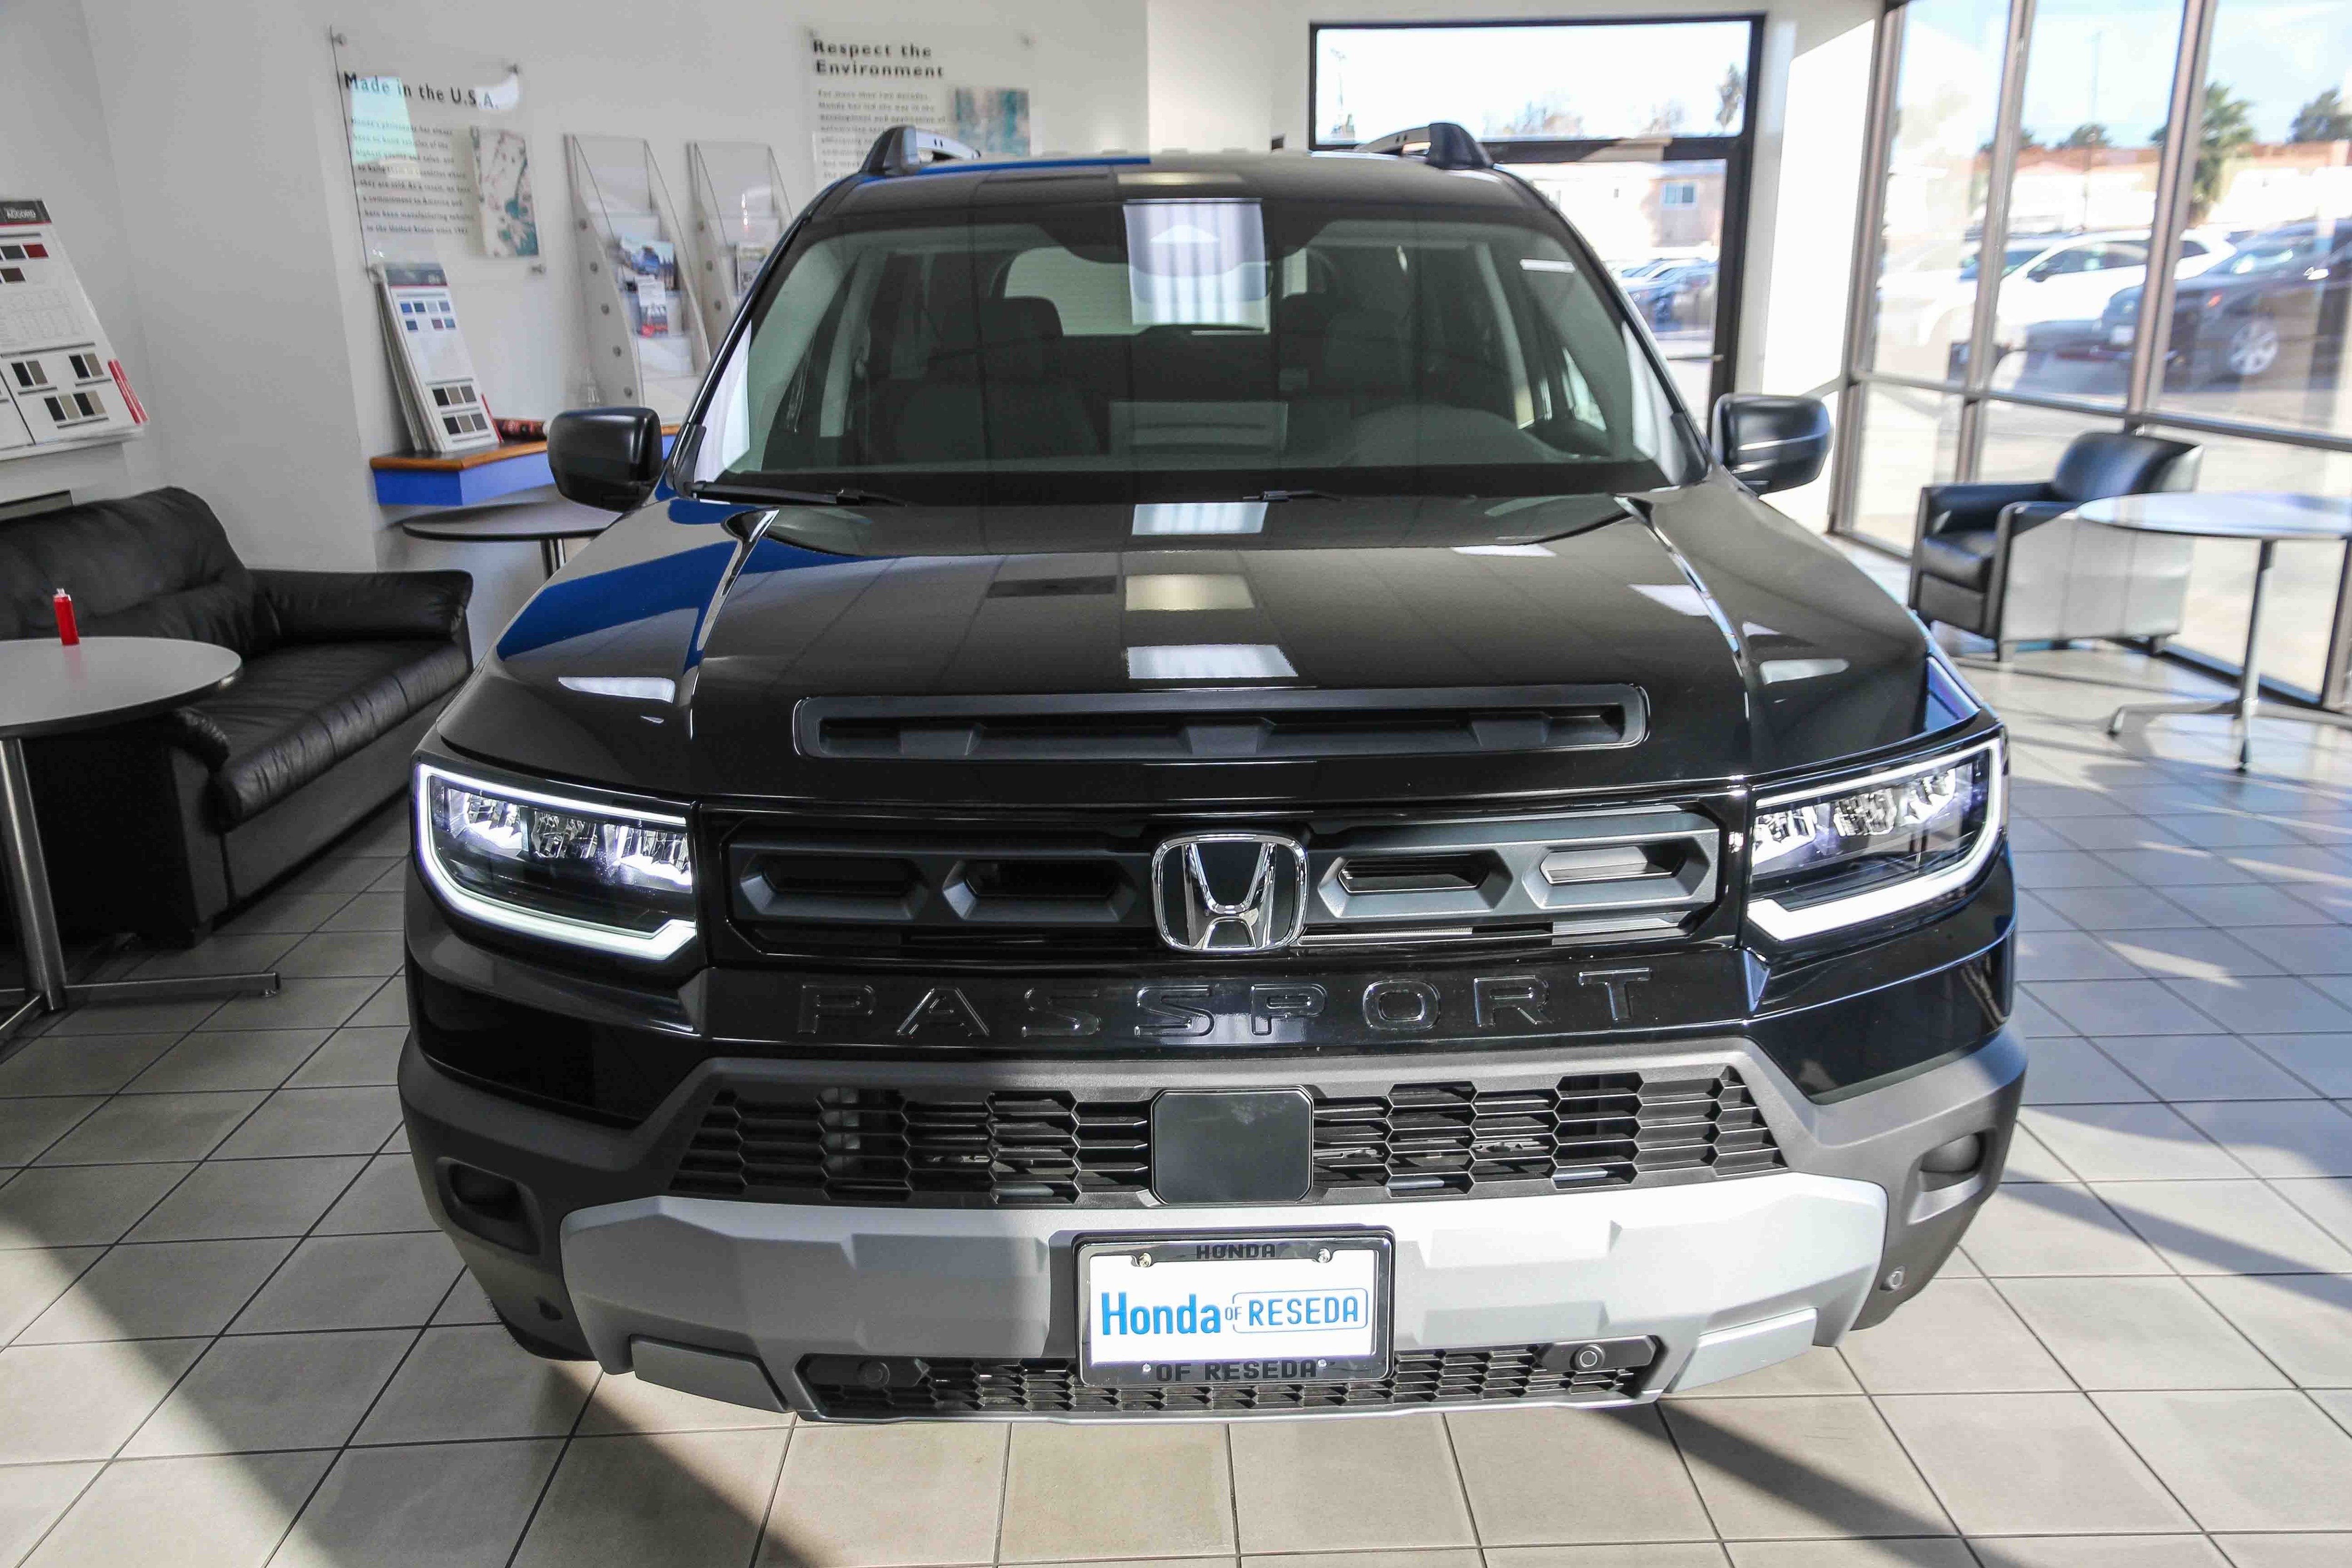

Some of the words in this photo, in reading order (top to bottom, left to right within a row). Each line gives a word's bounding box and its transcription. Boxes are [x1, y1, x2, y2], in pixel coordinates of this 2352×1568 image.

[813, 39, 892, 60] Respect
[901, 43, 931, 58] the
[816, 59, 945, 76] Environment
[344, 71, 390, 94] Made
[397, 78, 412, 98] in
[418, 83, 445, 102] the
[451, 86, 500, 109] U.S.A.
[798, 967, 1652, 1036] PASSPORT
[1196, 1243, 1276, 1260] HONDA
[1101, 1291, 1221, 1336] Honda
[1224, 1306, 1242, 1321] OF
[1248, 1296, 1359, 1326] RESEDA
[1156, 1363, 1192, 1382] OF
[1204, 1359, 1317, 1381] RESEDA
